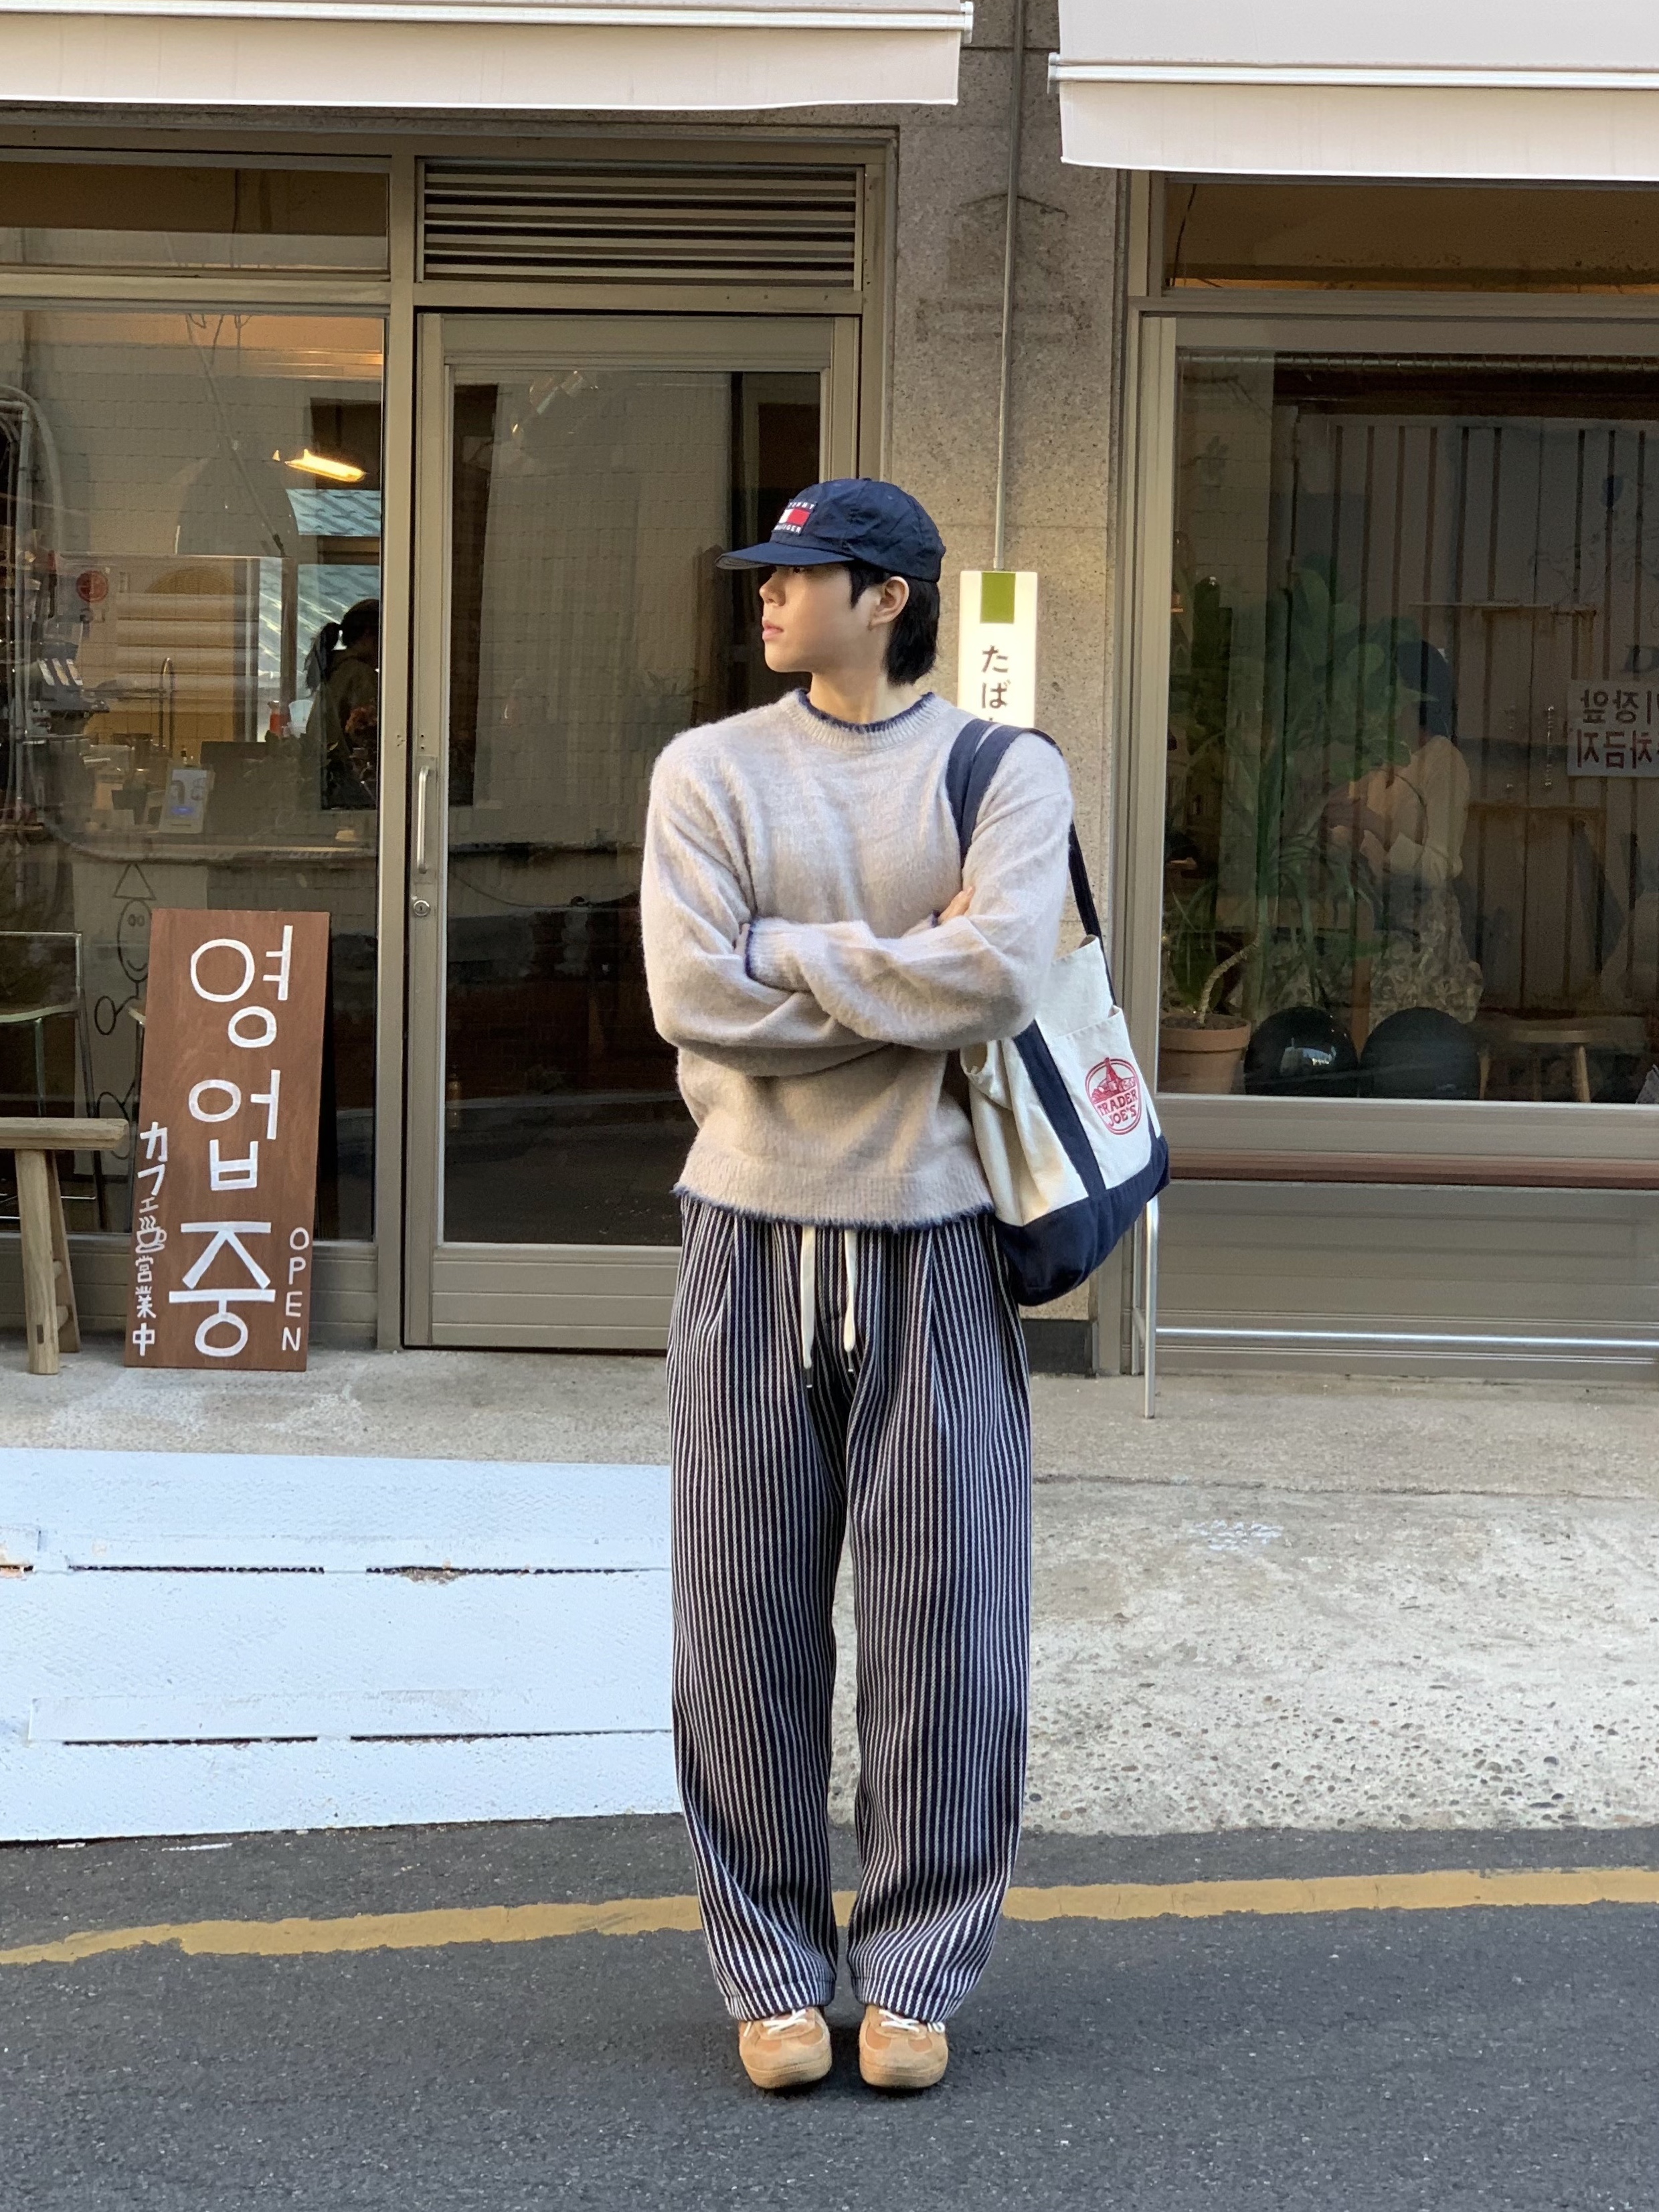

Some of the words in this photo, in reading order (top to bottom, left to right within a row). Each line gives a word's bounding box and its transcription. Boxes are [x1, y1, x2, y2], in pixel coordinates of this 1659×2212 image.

[774, 524, 802, 533] IGER
[981, 645, 1011, 721] たば
[1097, 1089, 1138, 1116] TRADER
[1108, 1104, 1137, 1127] JOE'S
[169, 925, 293, 1357] 영업중
[282, 1227, 310, 1351] OPEN
